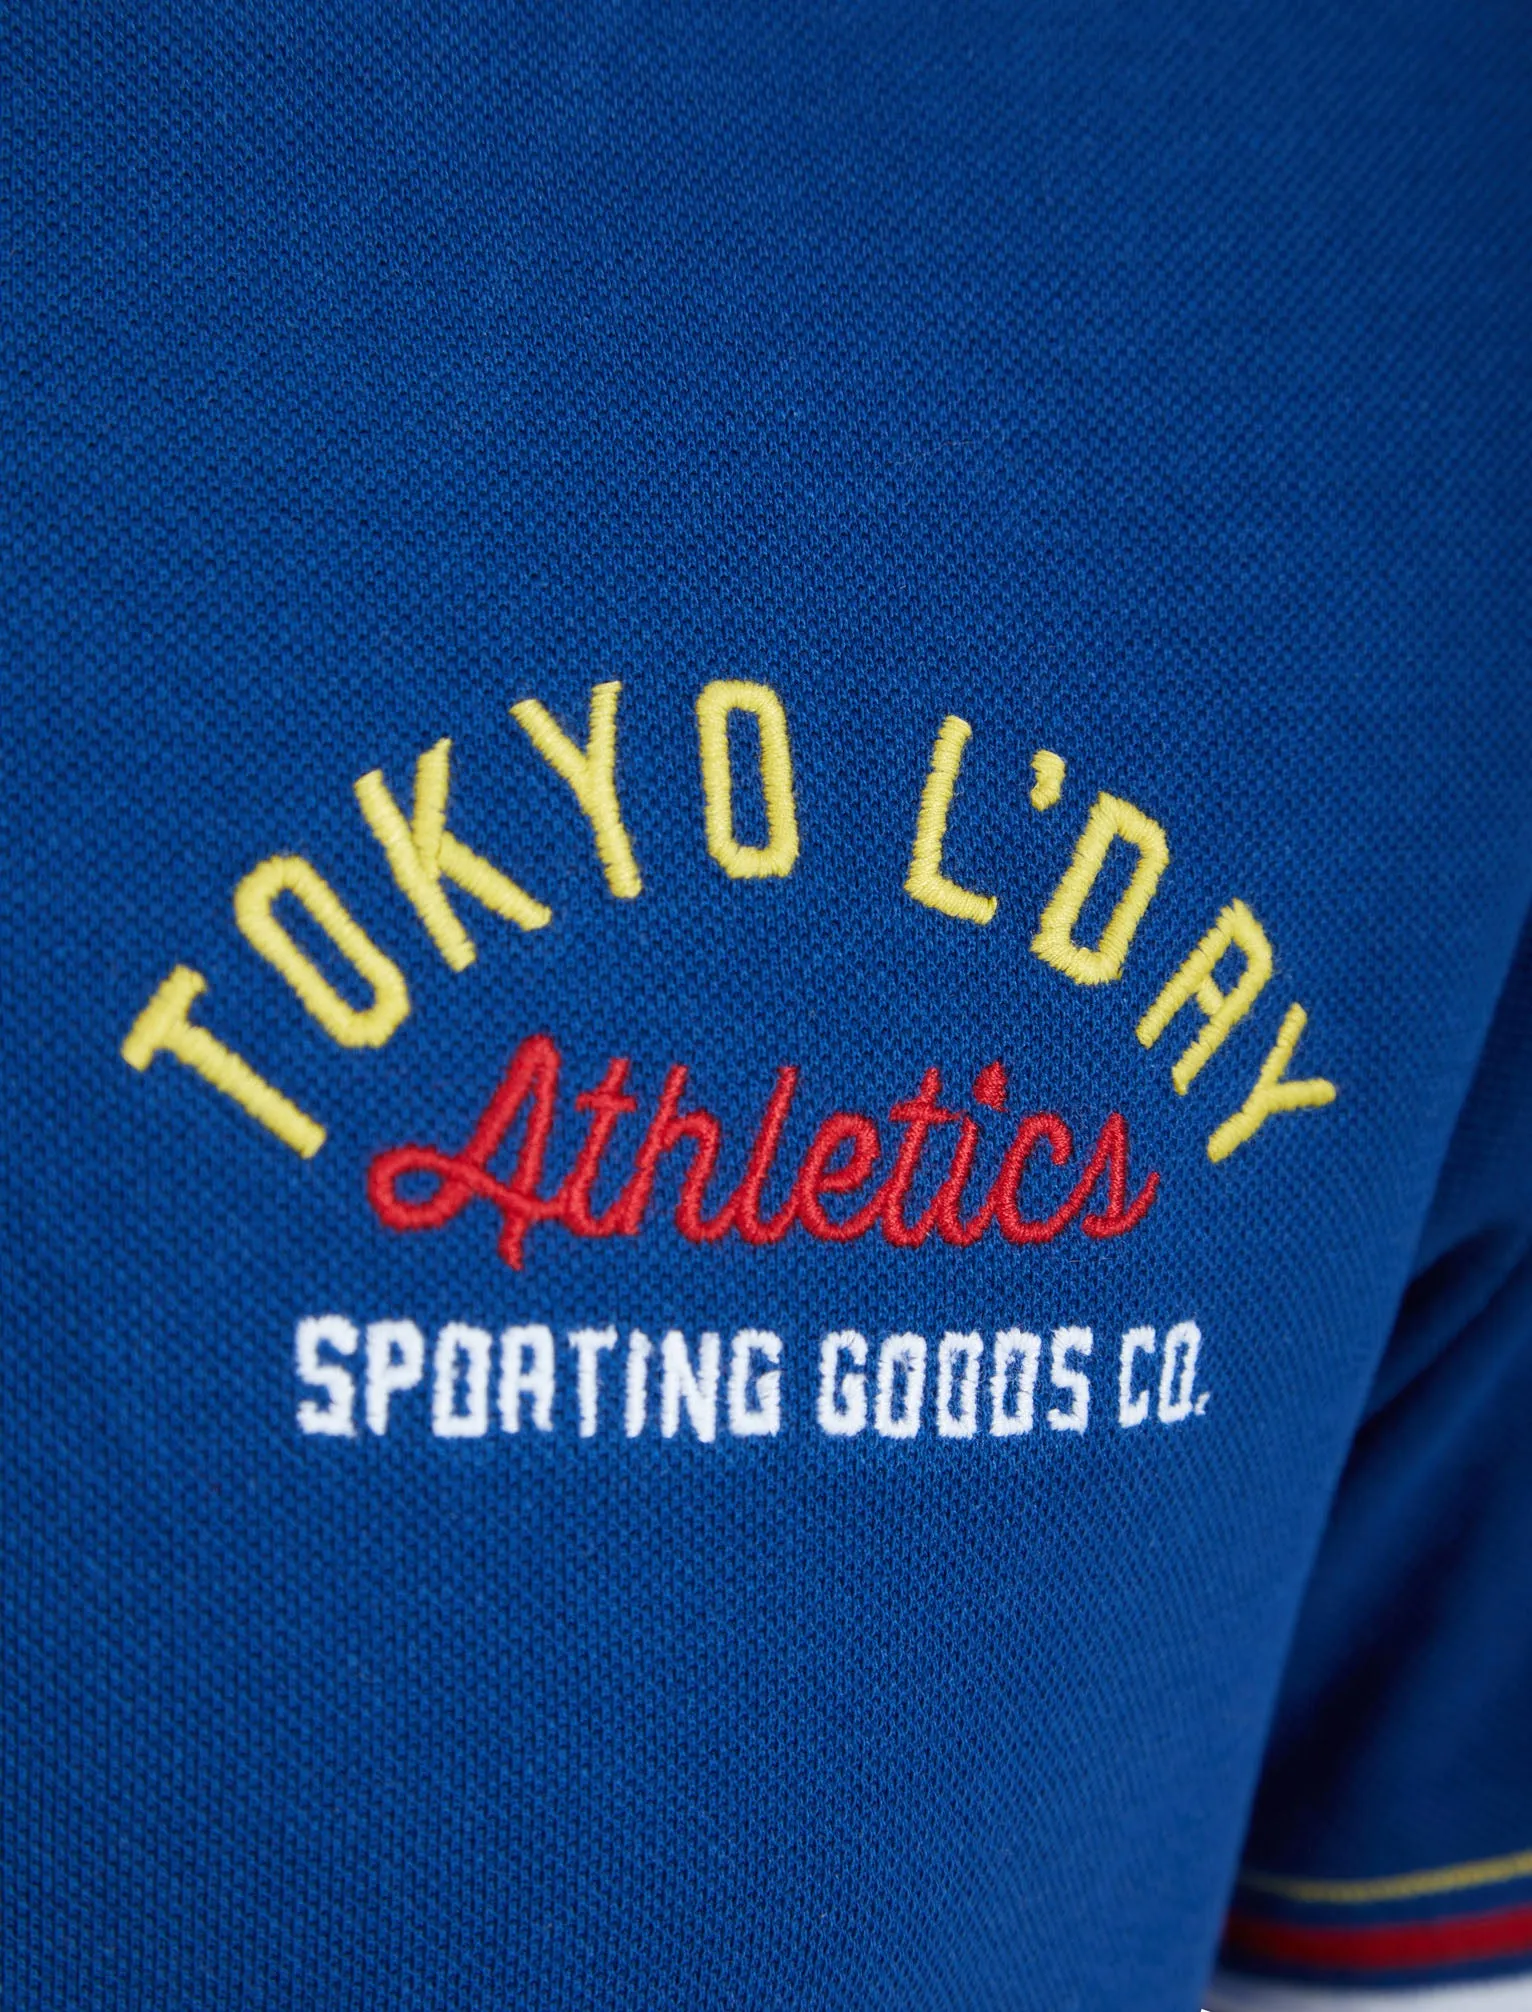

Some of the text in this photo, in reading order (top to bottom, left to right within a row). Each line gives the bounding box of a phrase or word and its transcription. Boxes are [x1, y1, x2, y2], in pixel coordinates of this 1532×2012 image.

[122, 680, 1337, 1163] TOKYO L'DAY
[368, 1035, 1160, 1270] Athletics
[296, 1315, 1210, 1441] SPORTING GOODS CO.
